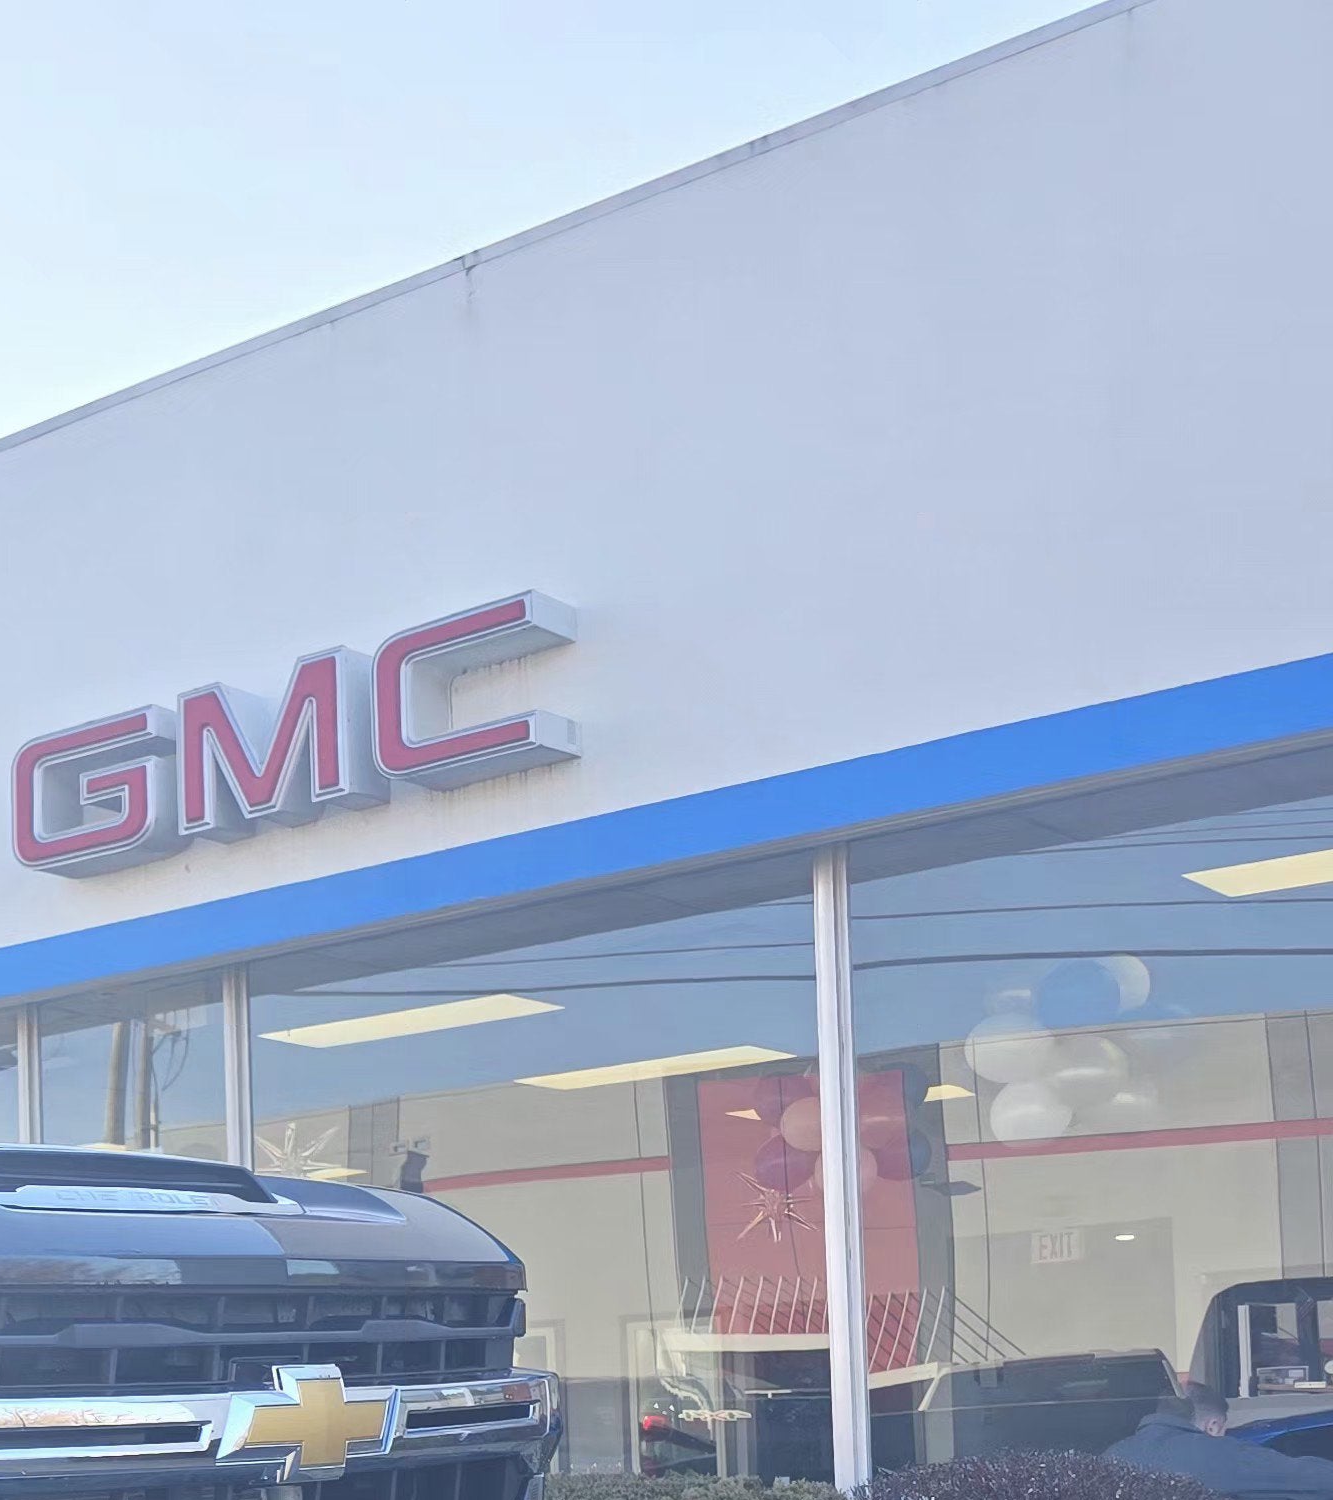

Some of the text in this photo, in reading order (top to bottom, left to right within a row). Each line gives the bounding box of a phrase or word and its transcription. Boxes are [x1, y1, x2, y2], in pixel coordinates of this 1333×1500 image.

[12, 589, 573, 874] GMC
[54, 1188, 222, 1206] CHEROLE
[1038, 1231, 1074, 1261] EXIT
